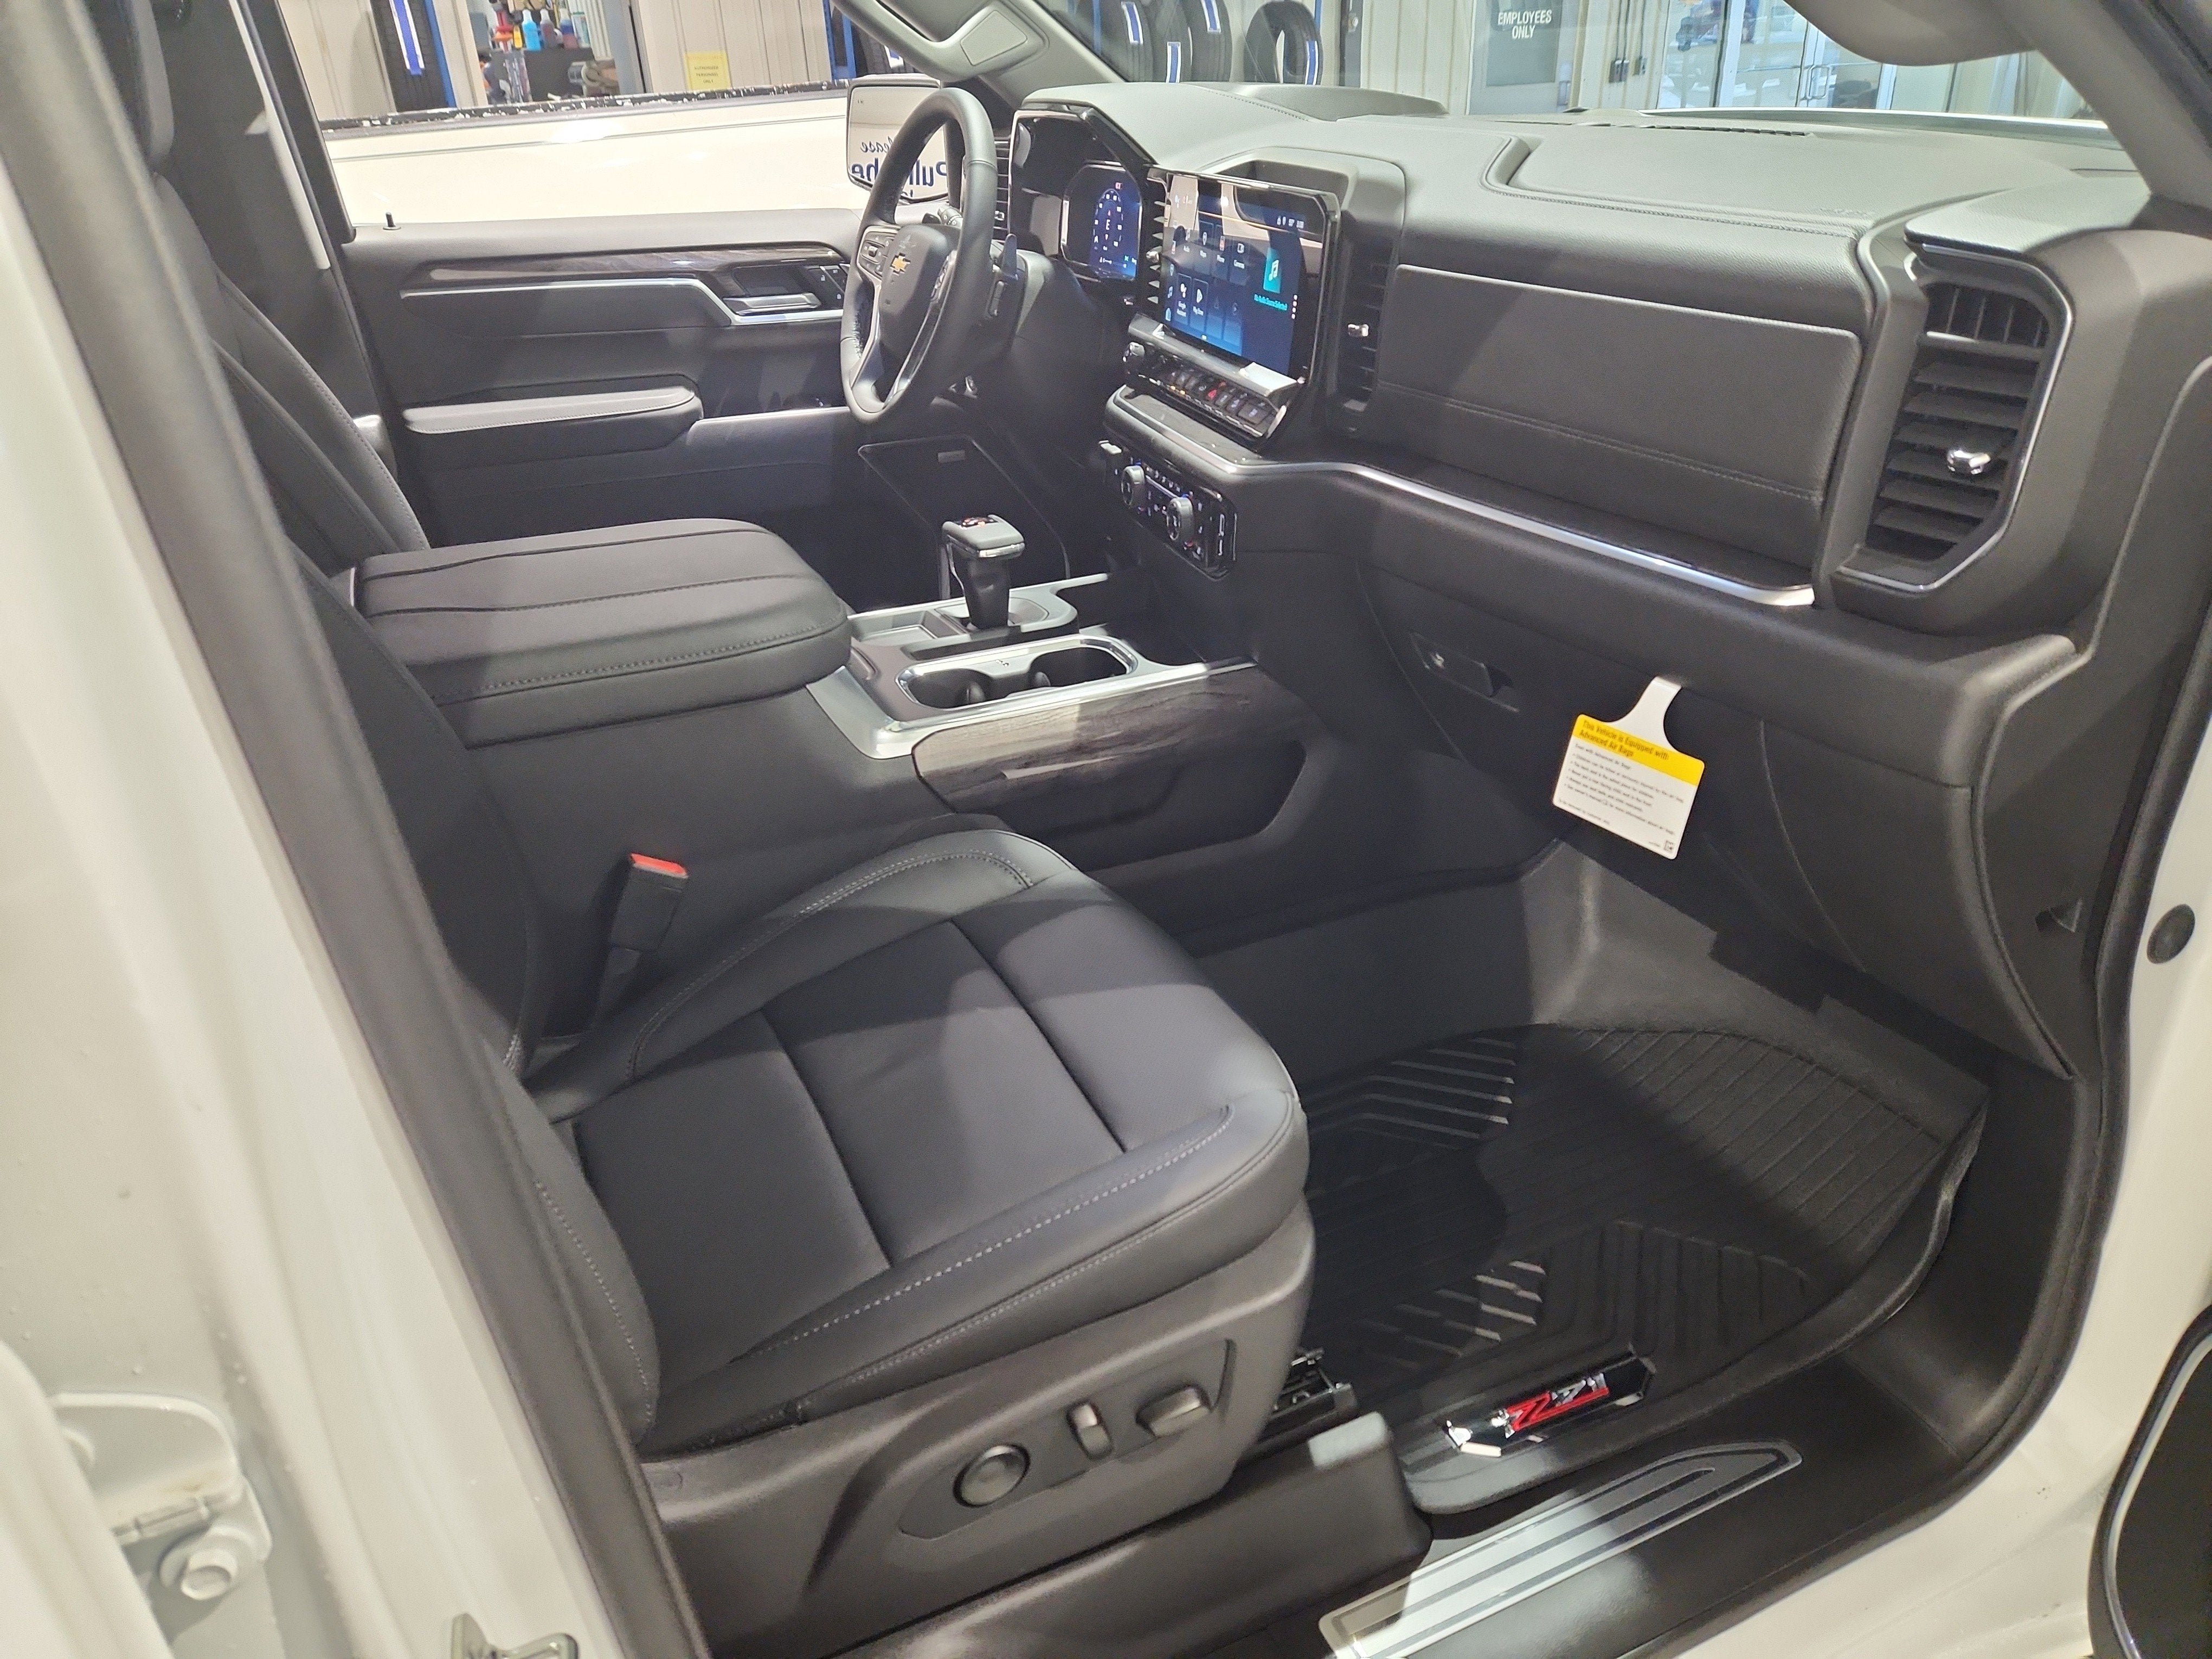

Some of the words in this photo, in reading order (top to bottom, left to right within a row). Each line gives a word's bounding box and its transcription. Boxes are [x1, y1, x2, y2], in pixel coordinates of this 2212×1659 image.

[1497, 9, 1552, 25] EMPLOYEES
[1512, 25, 1536, 40] ONLY
[1506, 1372, 1609, 1433] Z71
